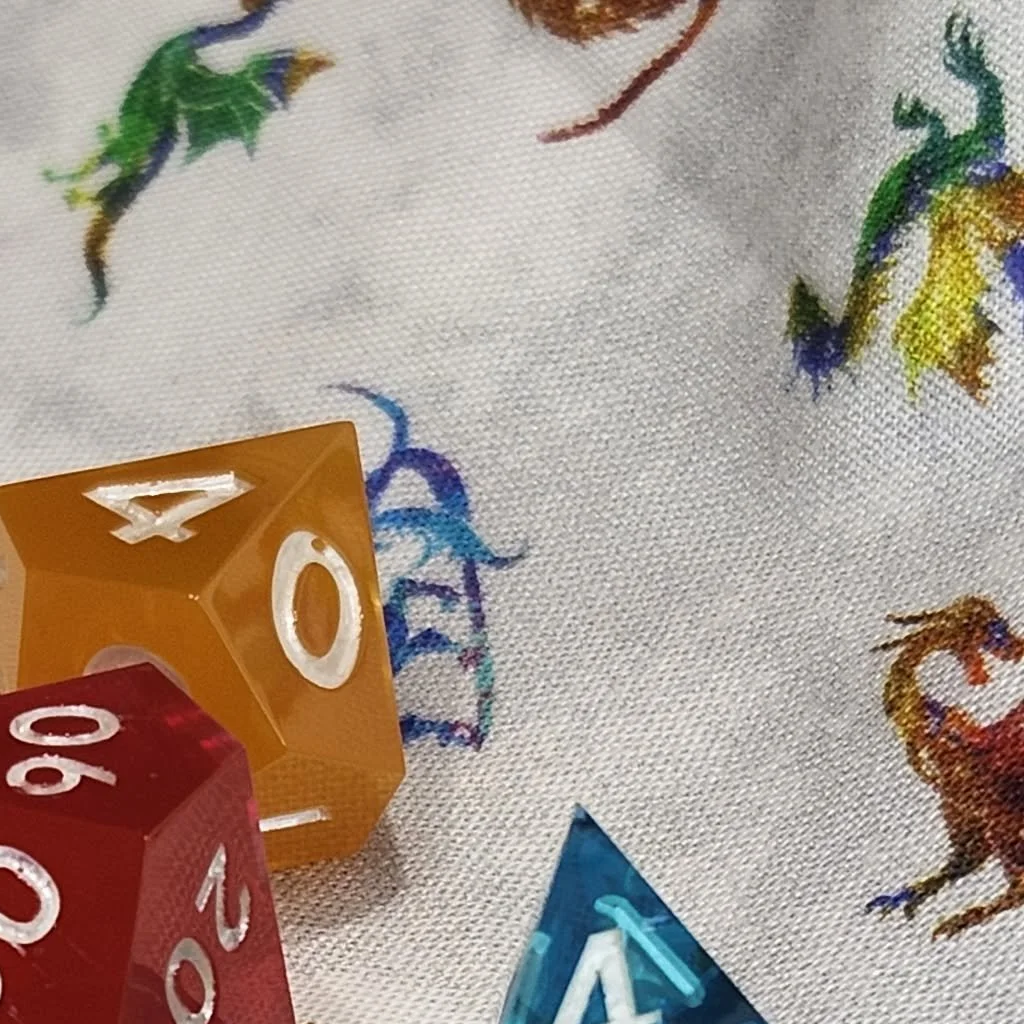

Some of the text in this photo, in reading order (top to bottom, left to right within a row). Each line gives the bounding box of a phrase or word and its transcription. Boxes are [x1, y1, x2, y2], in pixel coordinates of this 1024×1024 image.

[82, 470, 255, 545] 4
[271, 530, 364, 690] 0
[6, 703, 121, 795] 90
